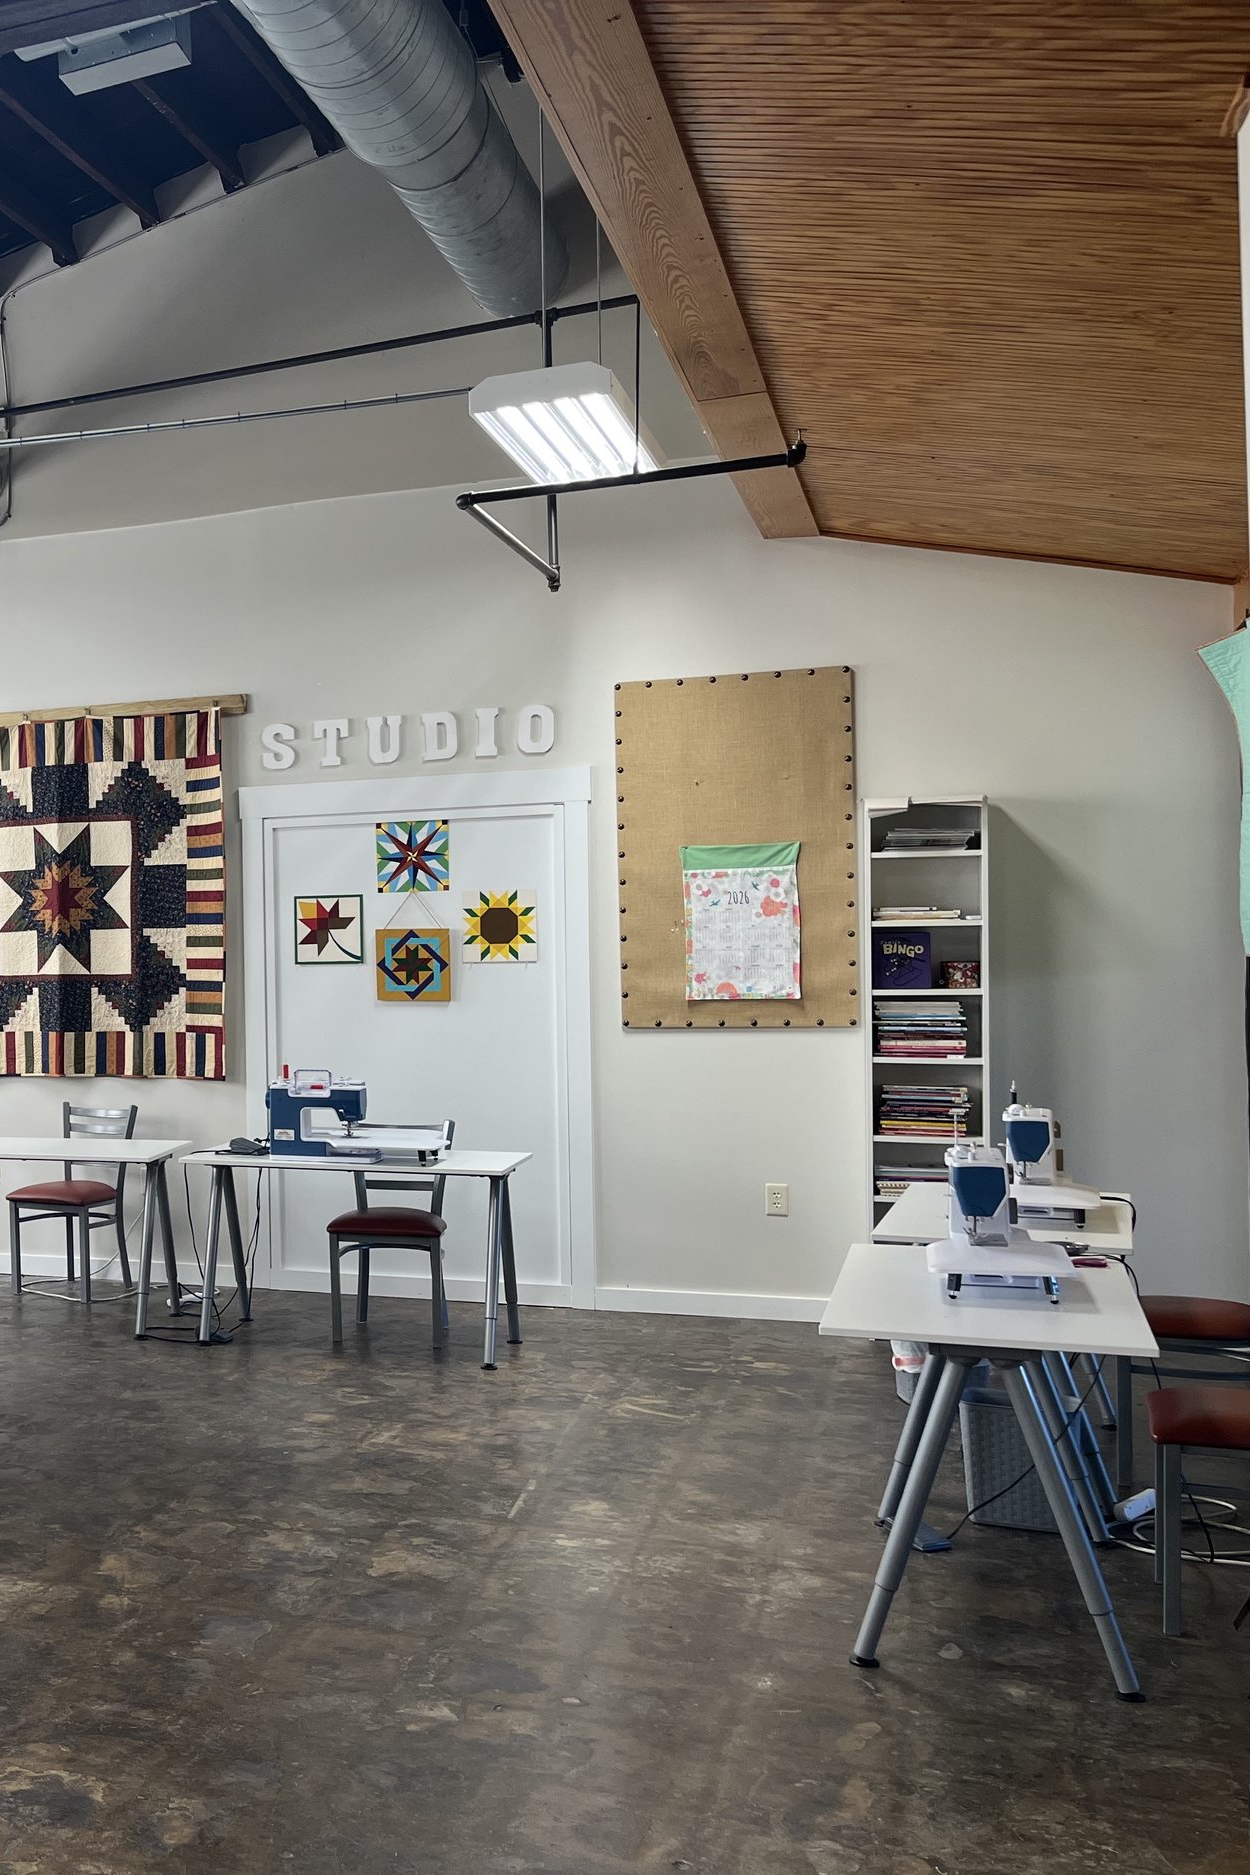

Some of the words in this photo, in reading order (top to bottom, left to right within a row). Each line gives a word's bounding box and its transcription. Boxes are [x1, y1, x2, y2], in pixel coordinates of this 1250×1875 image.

[261, 704, 555, 770] STUDIO
[727, 890, 750, 905] 2026
[883, 943, 925, 958] BINGO
